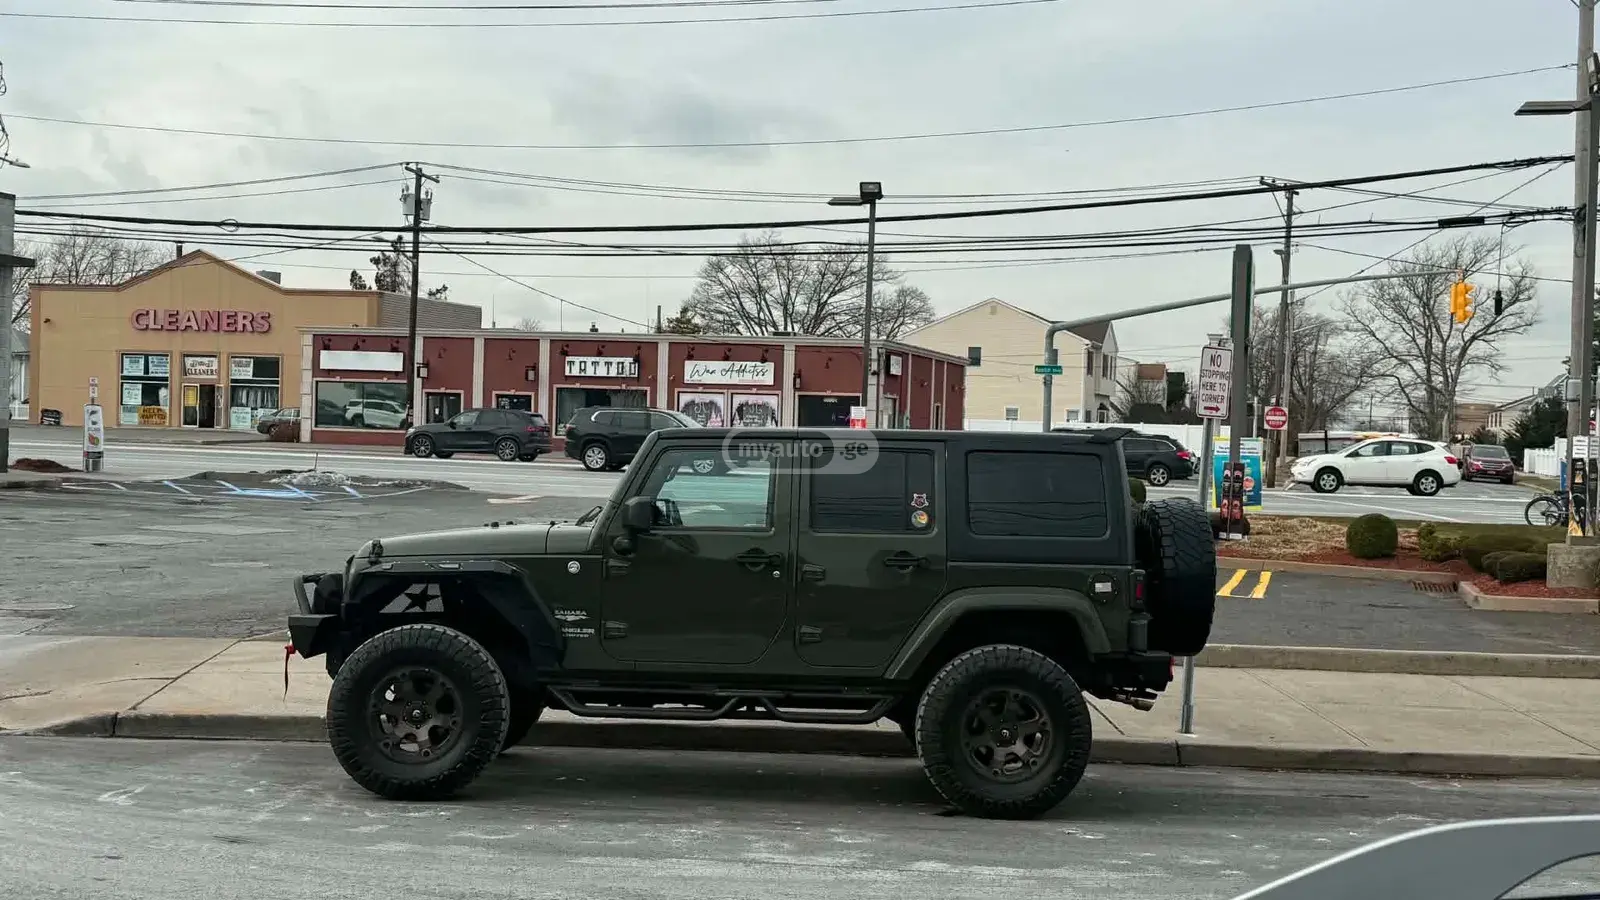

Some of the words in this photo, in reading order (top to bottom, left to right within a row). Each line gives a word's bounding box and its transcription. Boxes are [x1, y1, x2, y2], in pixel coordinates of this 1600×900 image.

[131, 308, 272, 333] CLEANERS
[1210, 354, 1222, 367] NO
[567, 361, 636, 376] TATTOO
[689, 363, 716, 378] Wax
[1201, 369, 1230, 380] STOPPING
[1201, 381, 1216, 391] HERE
[1218, 382, 1226, 392] TO
[1201, 393, 1225, 404] CORNER
